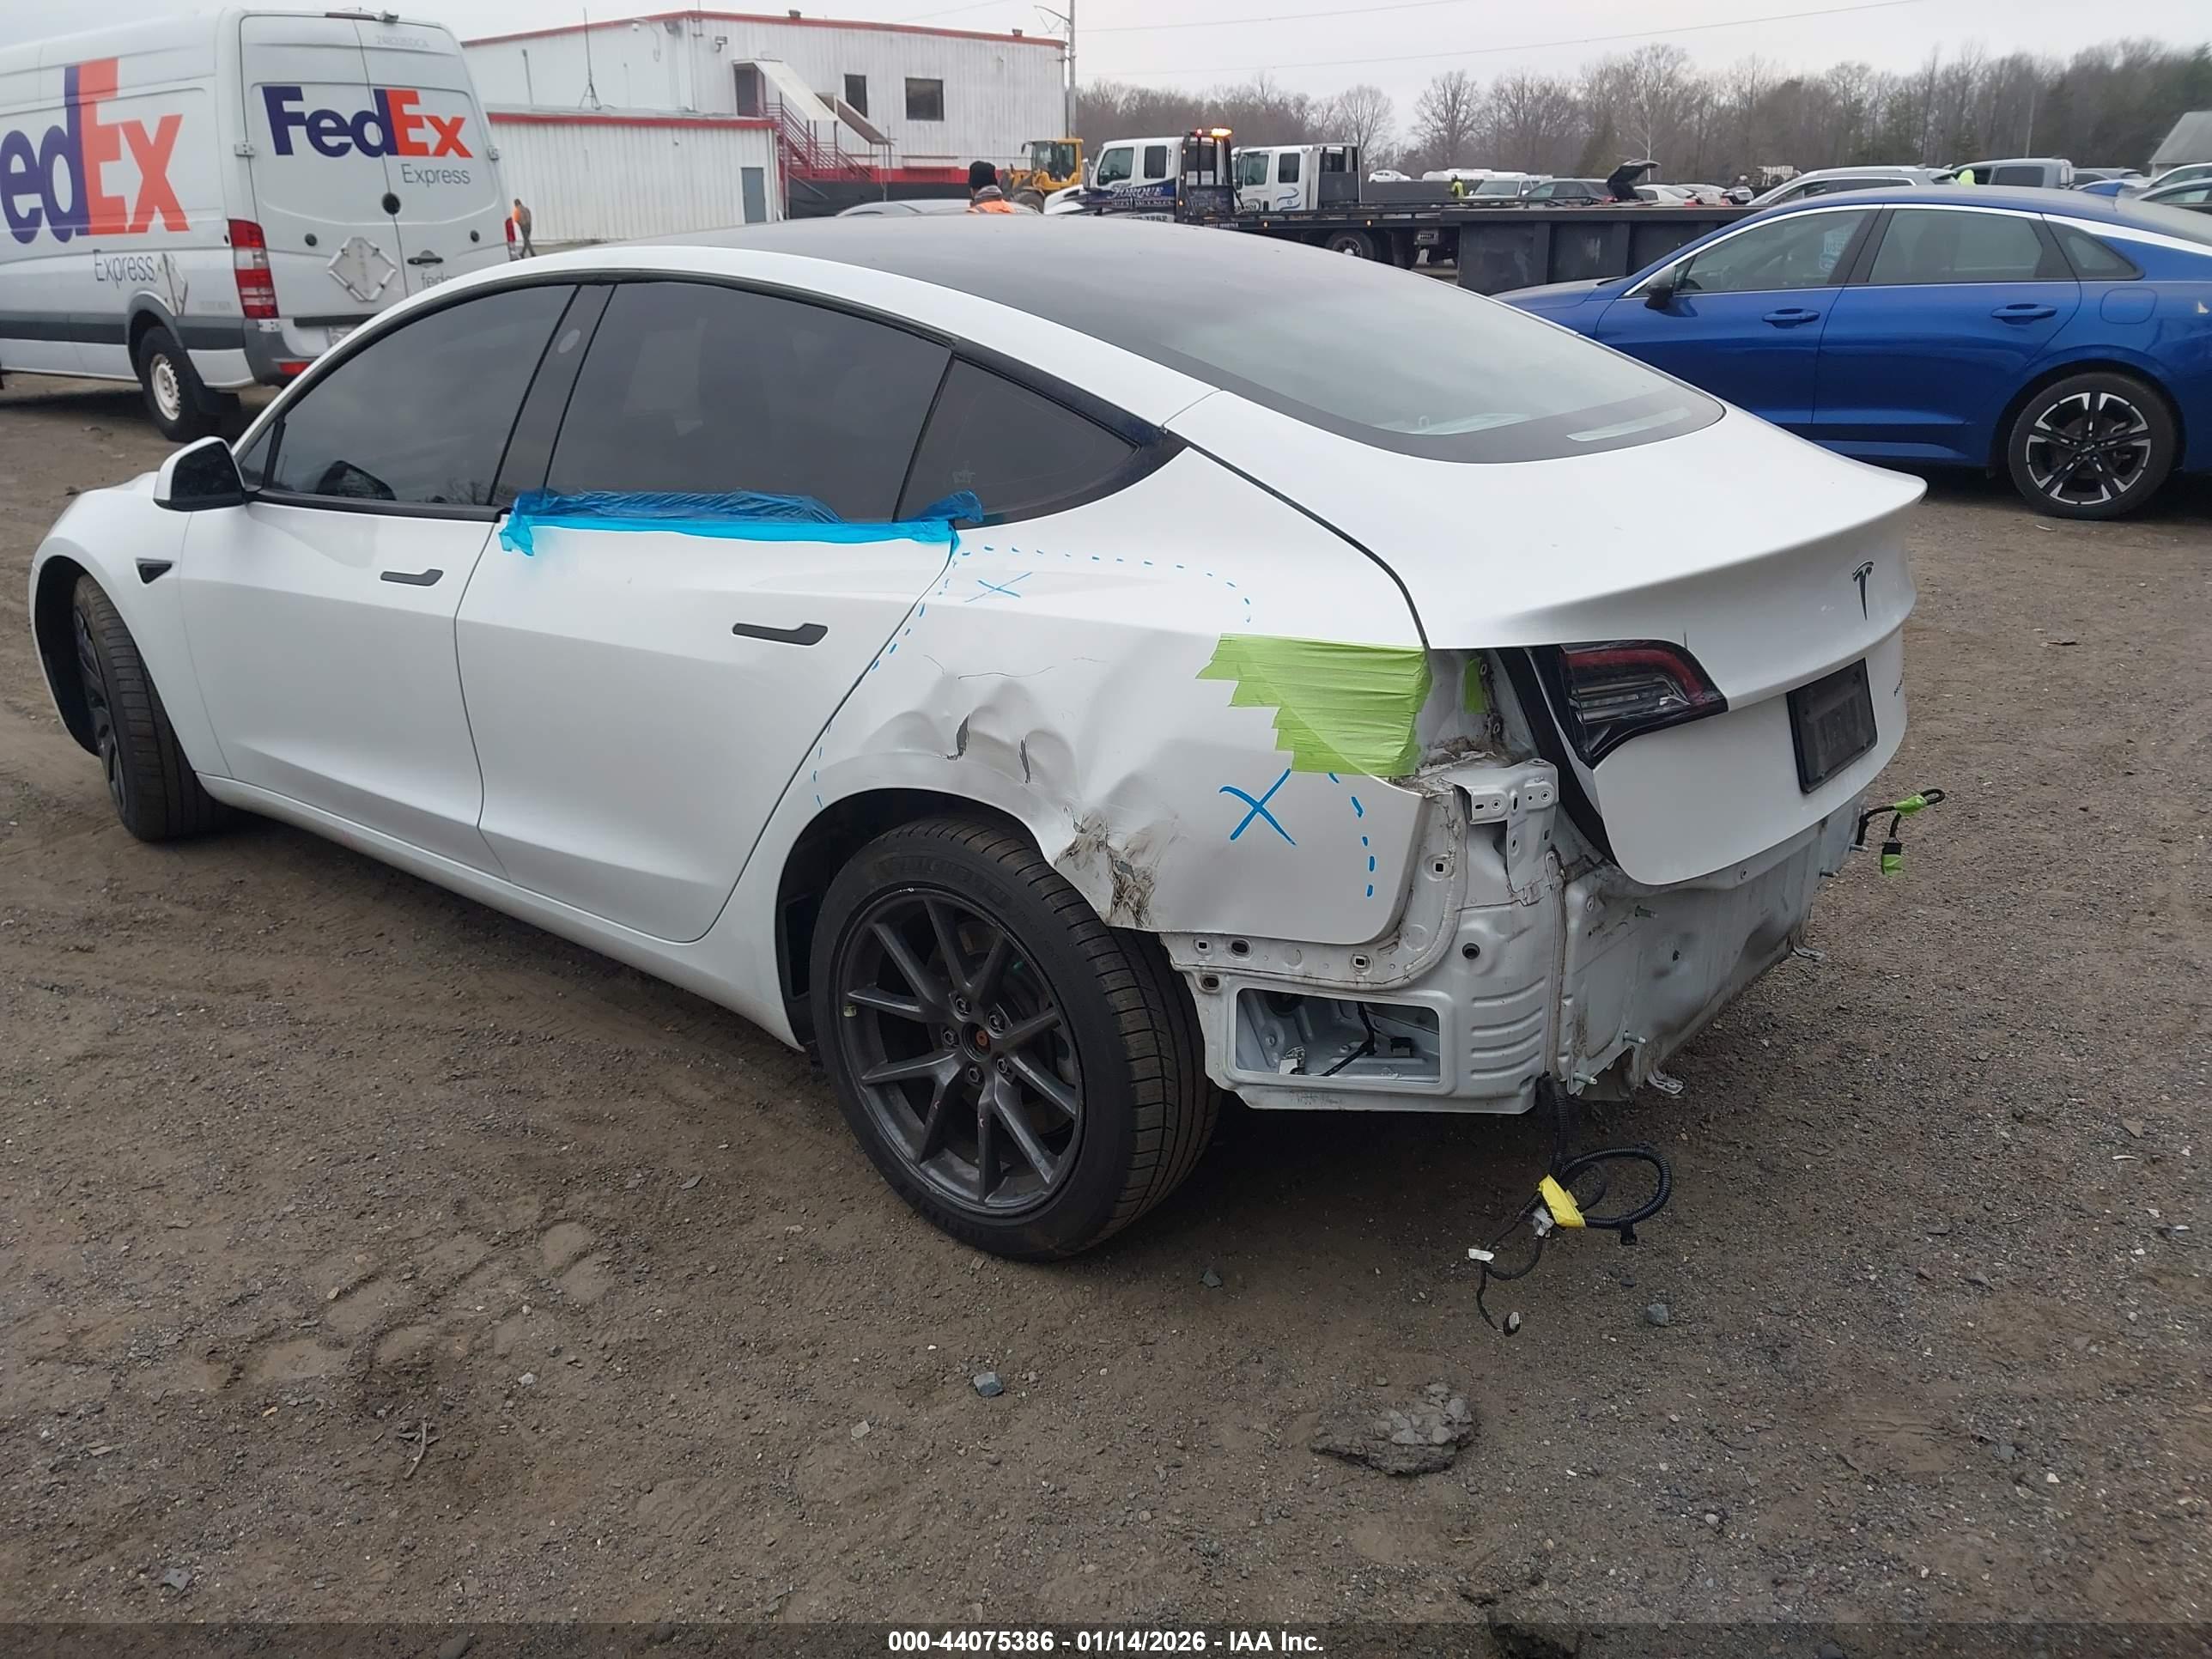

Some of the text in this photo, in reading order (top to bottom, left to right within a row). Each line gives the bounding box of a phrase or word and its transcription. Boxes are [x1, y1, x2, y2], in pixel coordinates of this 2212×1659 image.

[261, 86, 473, 158] FedEx
[0, 58, 190, 245] edEx
[401, 164, 471, 187] Express
[93, 249, 156, 289] Express
